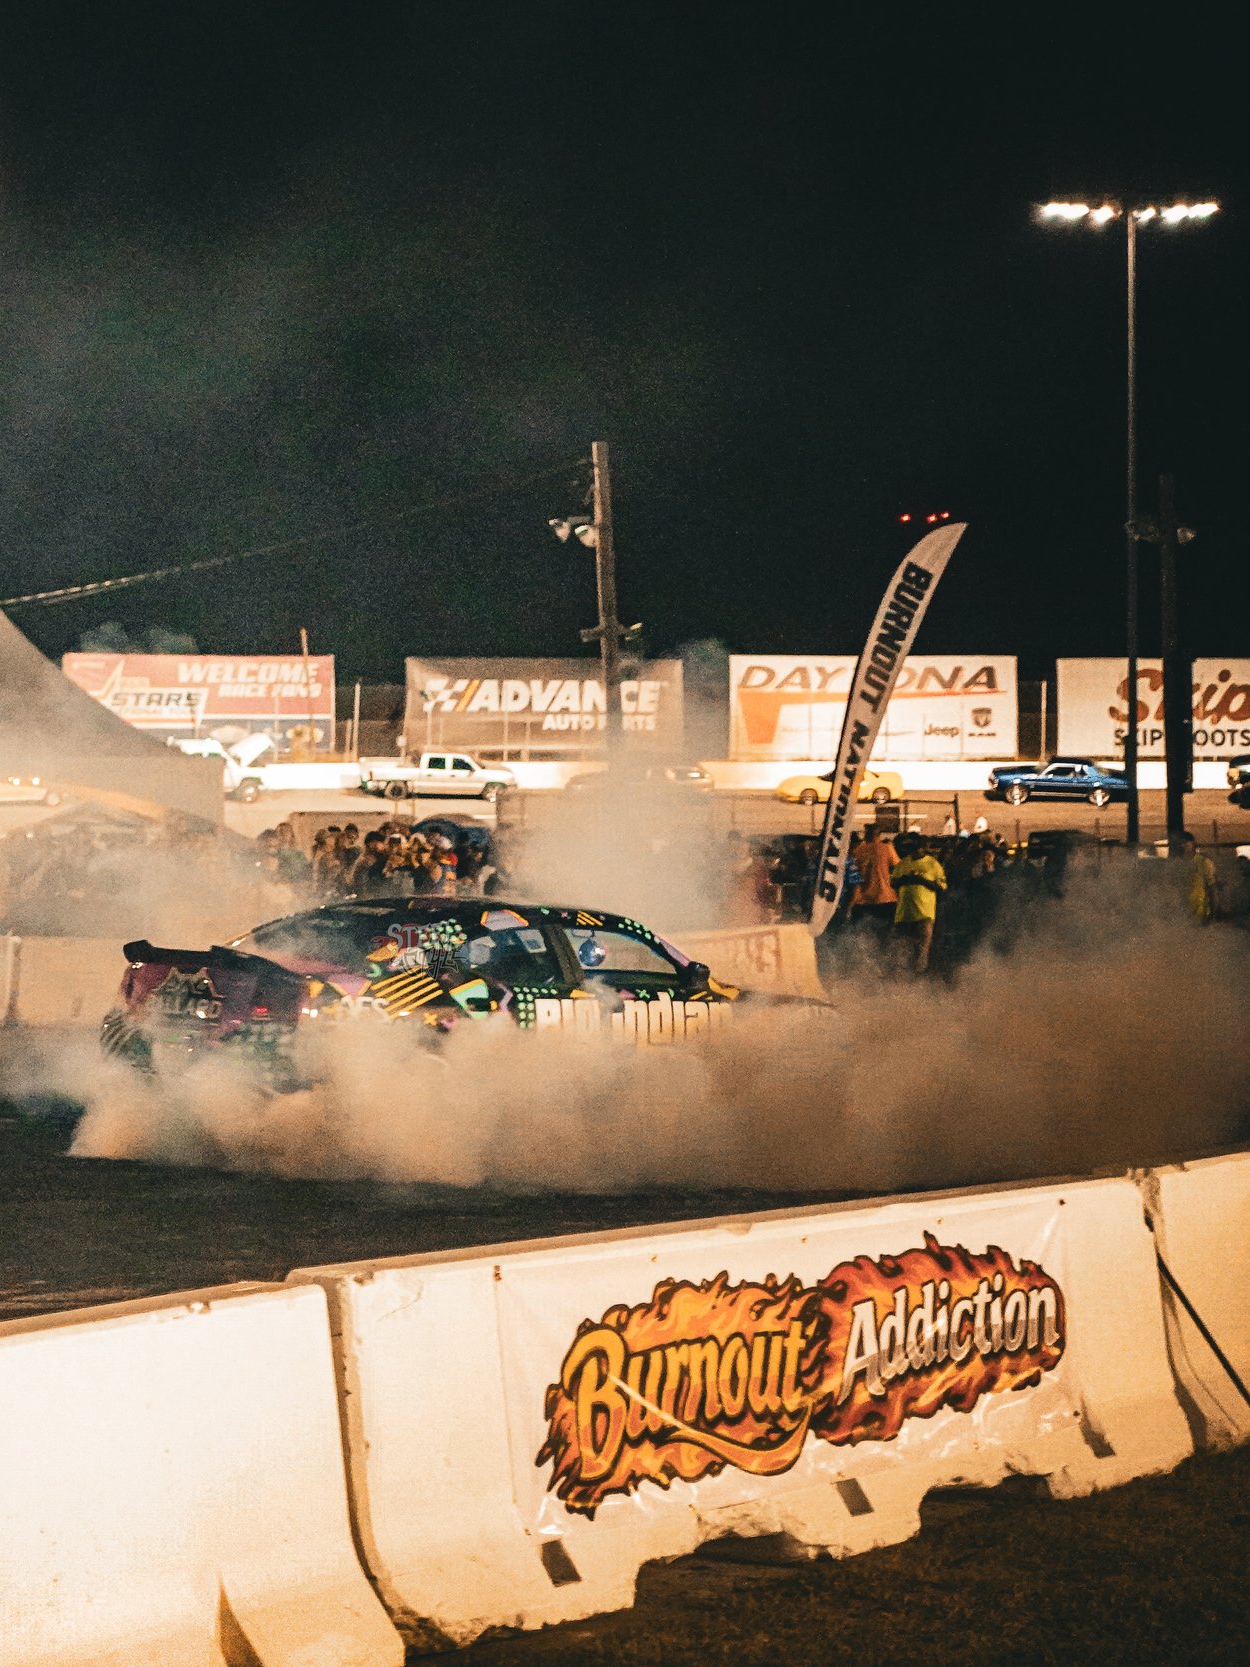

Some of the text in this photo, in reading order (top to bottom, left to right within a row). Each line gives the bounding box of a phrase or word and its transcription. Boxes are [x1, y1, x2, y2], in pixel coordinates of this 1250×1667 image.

[859, 560, 934, 715] BURNOUT
[178, 662, 318, 685] WELCOME
[739, 665, 1000, 690] DAYONA
[111, 692, 203, 708] STARS
[542, 714, 595, 731] AUTO
[923, 722, 961, 739] Jeep
[562, 1272, 1059, 1483] Burnout Addiction
